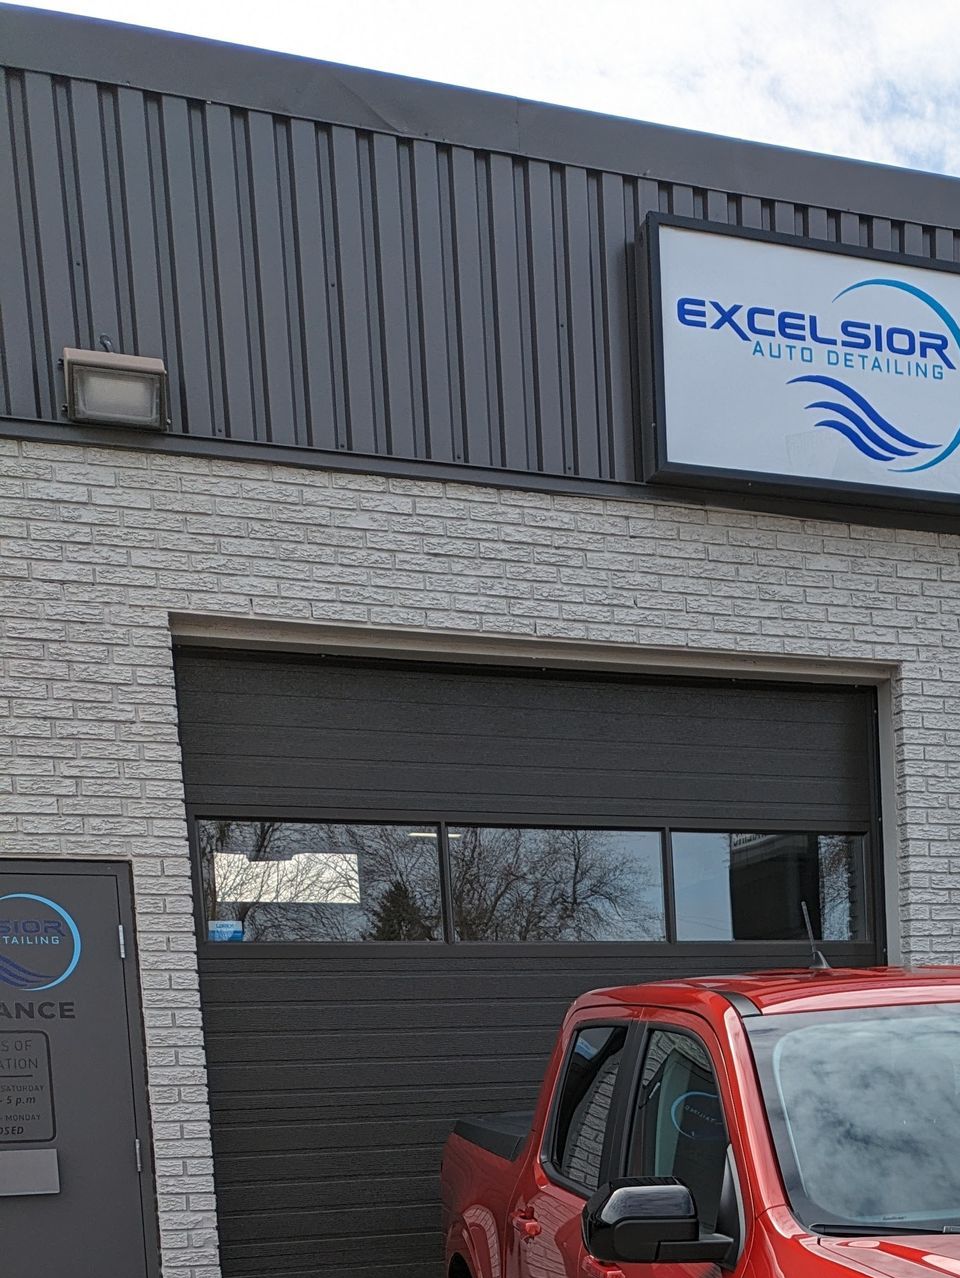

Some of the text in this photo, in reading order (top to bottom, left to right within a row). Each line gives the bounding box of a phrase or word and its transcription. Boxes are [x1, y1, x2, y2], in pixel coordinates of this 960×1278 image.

[676, 297, 957, 371] EXCELSIOR
[752, 340, 945, 380] AUTO DETAILING
[14, 1039, 32, 1051] OF
[5, 1113, 41, 1122] MONDAY
